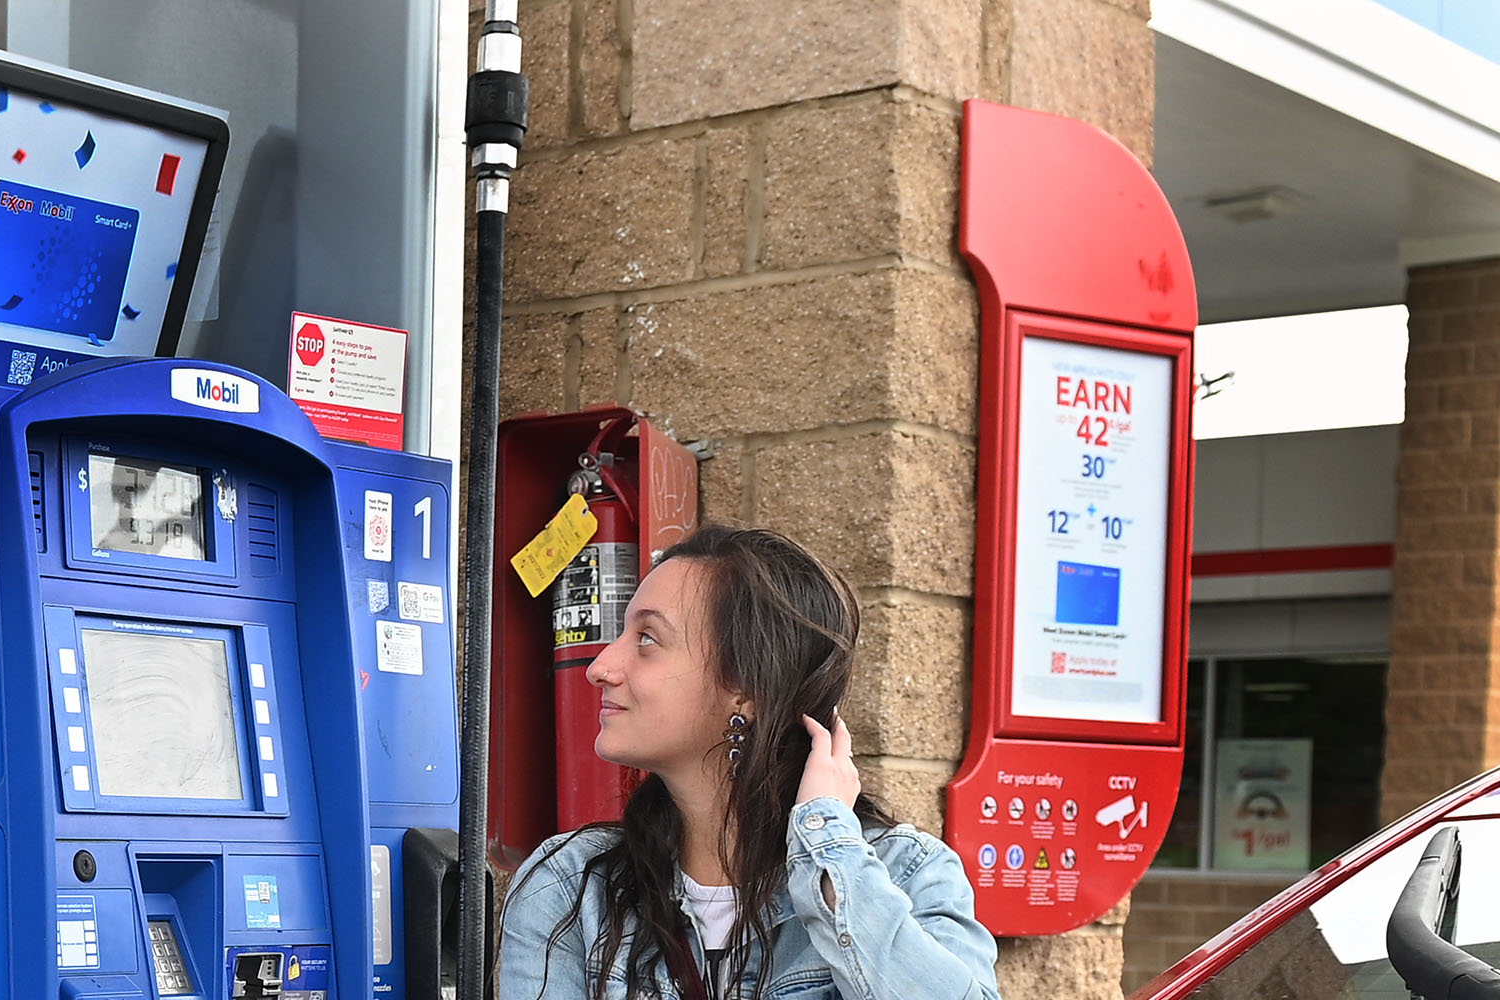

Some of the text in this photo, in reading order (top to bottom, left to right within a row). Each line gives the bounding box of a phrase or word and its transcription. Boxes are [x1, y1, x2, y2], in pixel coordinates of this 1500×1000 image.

[0, 192, 75, 222] Exxon Mobil
[95, 215, 114, 227] Smart
[297, 337, 323, 353] STOP
[197, 377, 239, 404] Mobil
[1057, 376, 1132, 415] EARN
[1077, 415, 1109, 447] 42
[1082, 455, 1105, 478] 30
[78, 468, 88, 492] $
[415, 497, 431, 559] 1
[1048, 510, 1068, 533] 12
[1102, 516, 1122, 539] 10
[997, 771, 1063, 788] For your safety
[1108, 777, 1138, 790] CCTV
